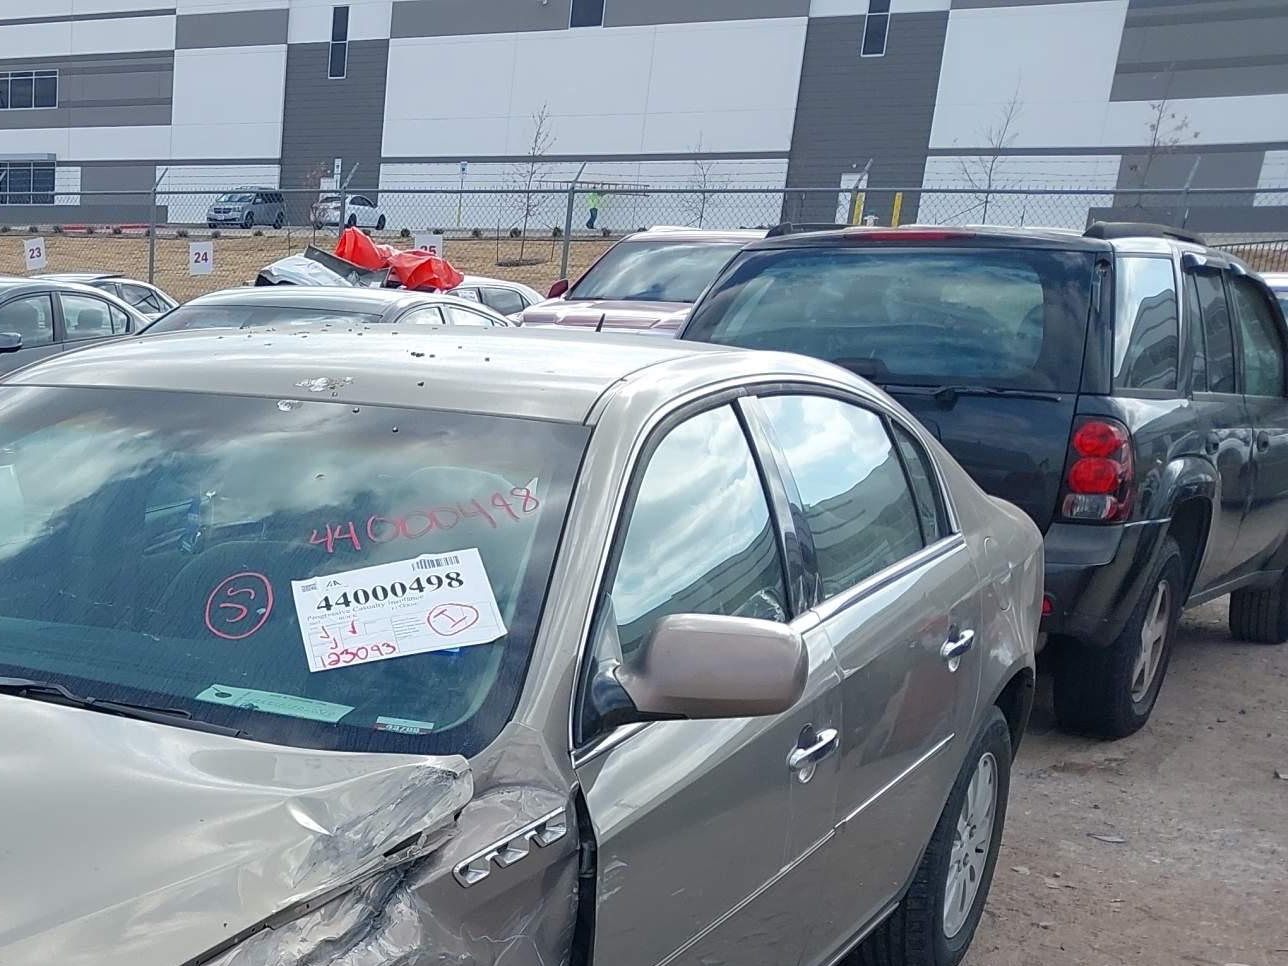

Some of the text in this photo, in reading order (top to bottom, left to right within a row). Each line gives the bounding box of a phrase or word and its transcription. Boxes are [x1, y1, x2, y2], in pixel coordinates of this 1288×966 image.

[28, 246, 42, 259] 23
[193, 251, 209, 264] 24
[310, 486, 540, 553] 44000498
[316, 571, 464, 611] 44000498
